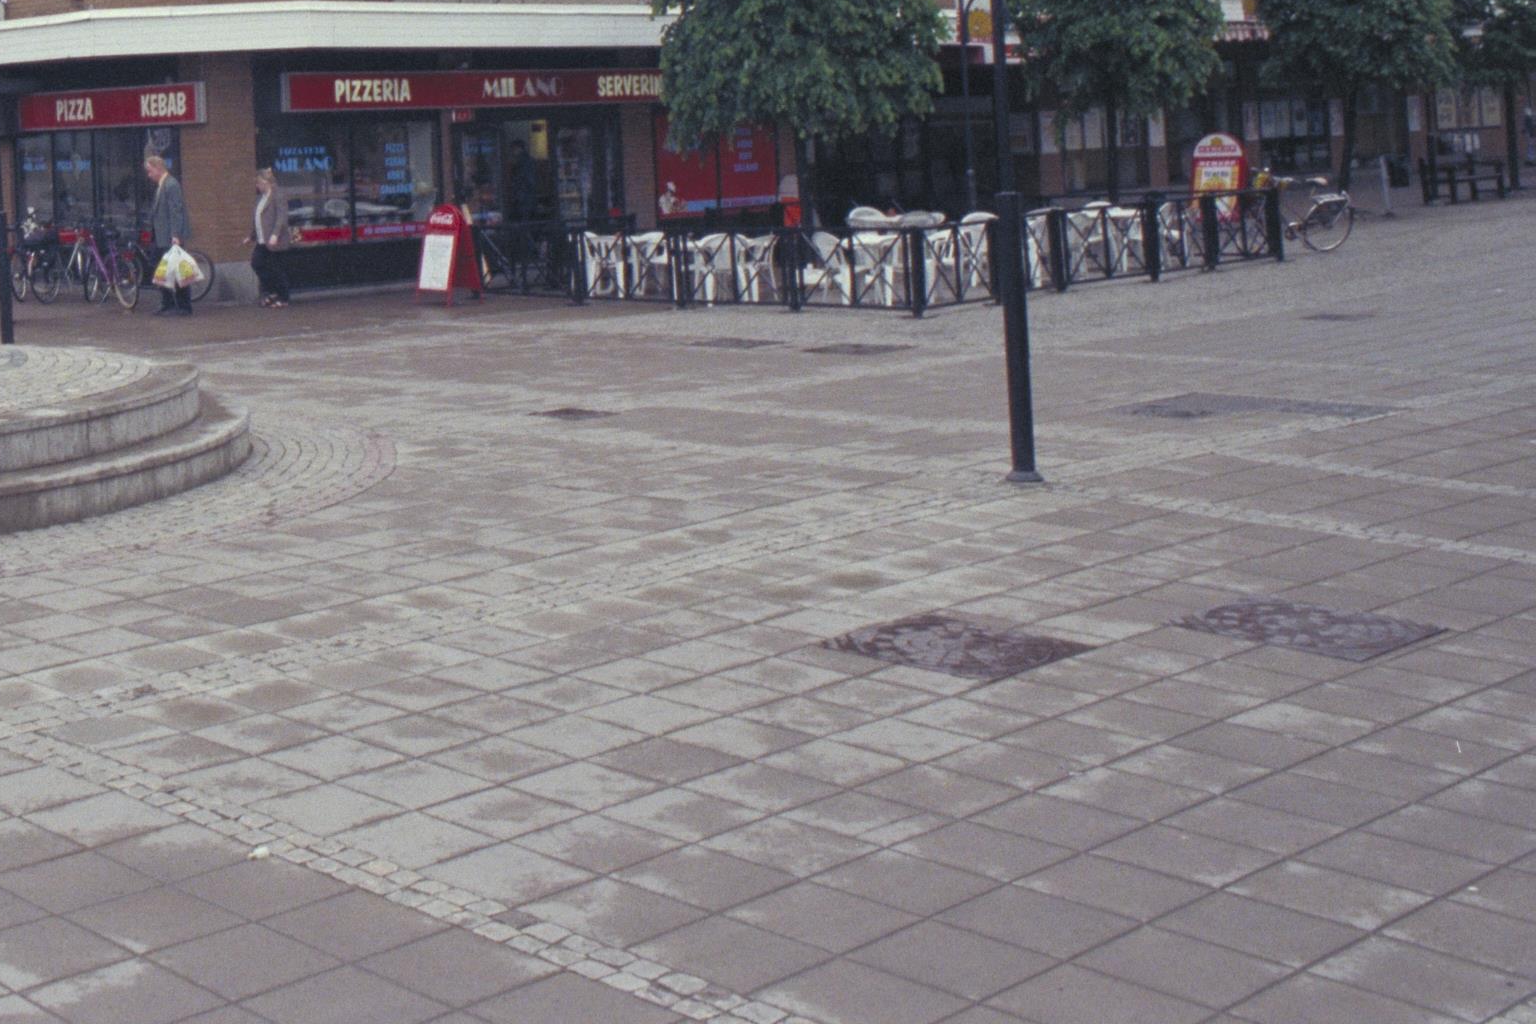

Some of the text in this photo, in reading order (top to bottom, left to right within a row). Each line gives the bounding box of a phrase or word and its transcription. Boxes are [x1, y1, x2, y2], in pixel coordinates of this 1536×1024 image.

[334, 74, 665, 103] PIZZERIA MILANO SERVERIN
[56, 91, 186, 122] PIZZA KEBAB
[274, 156, 333, 173] MILANO
